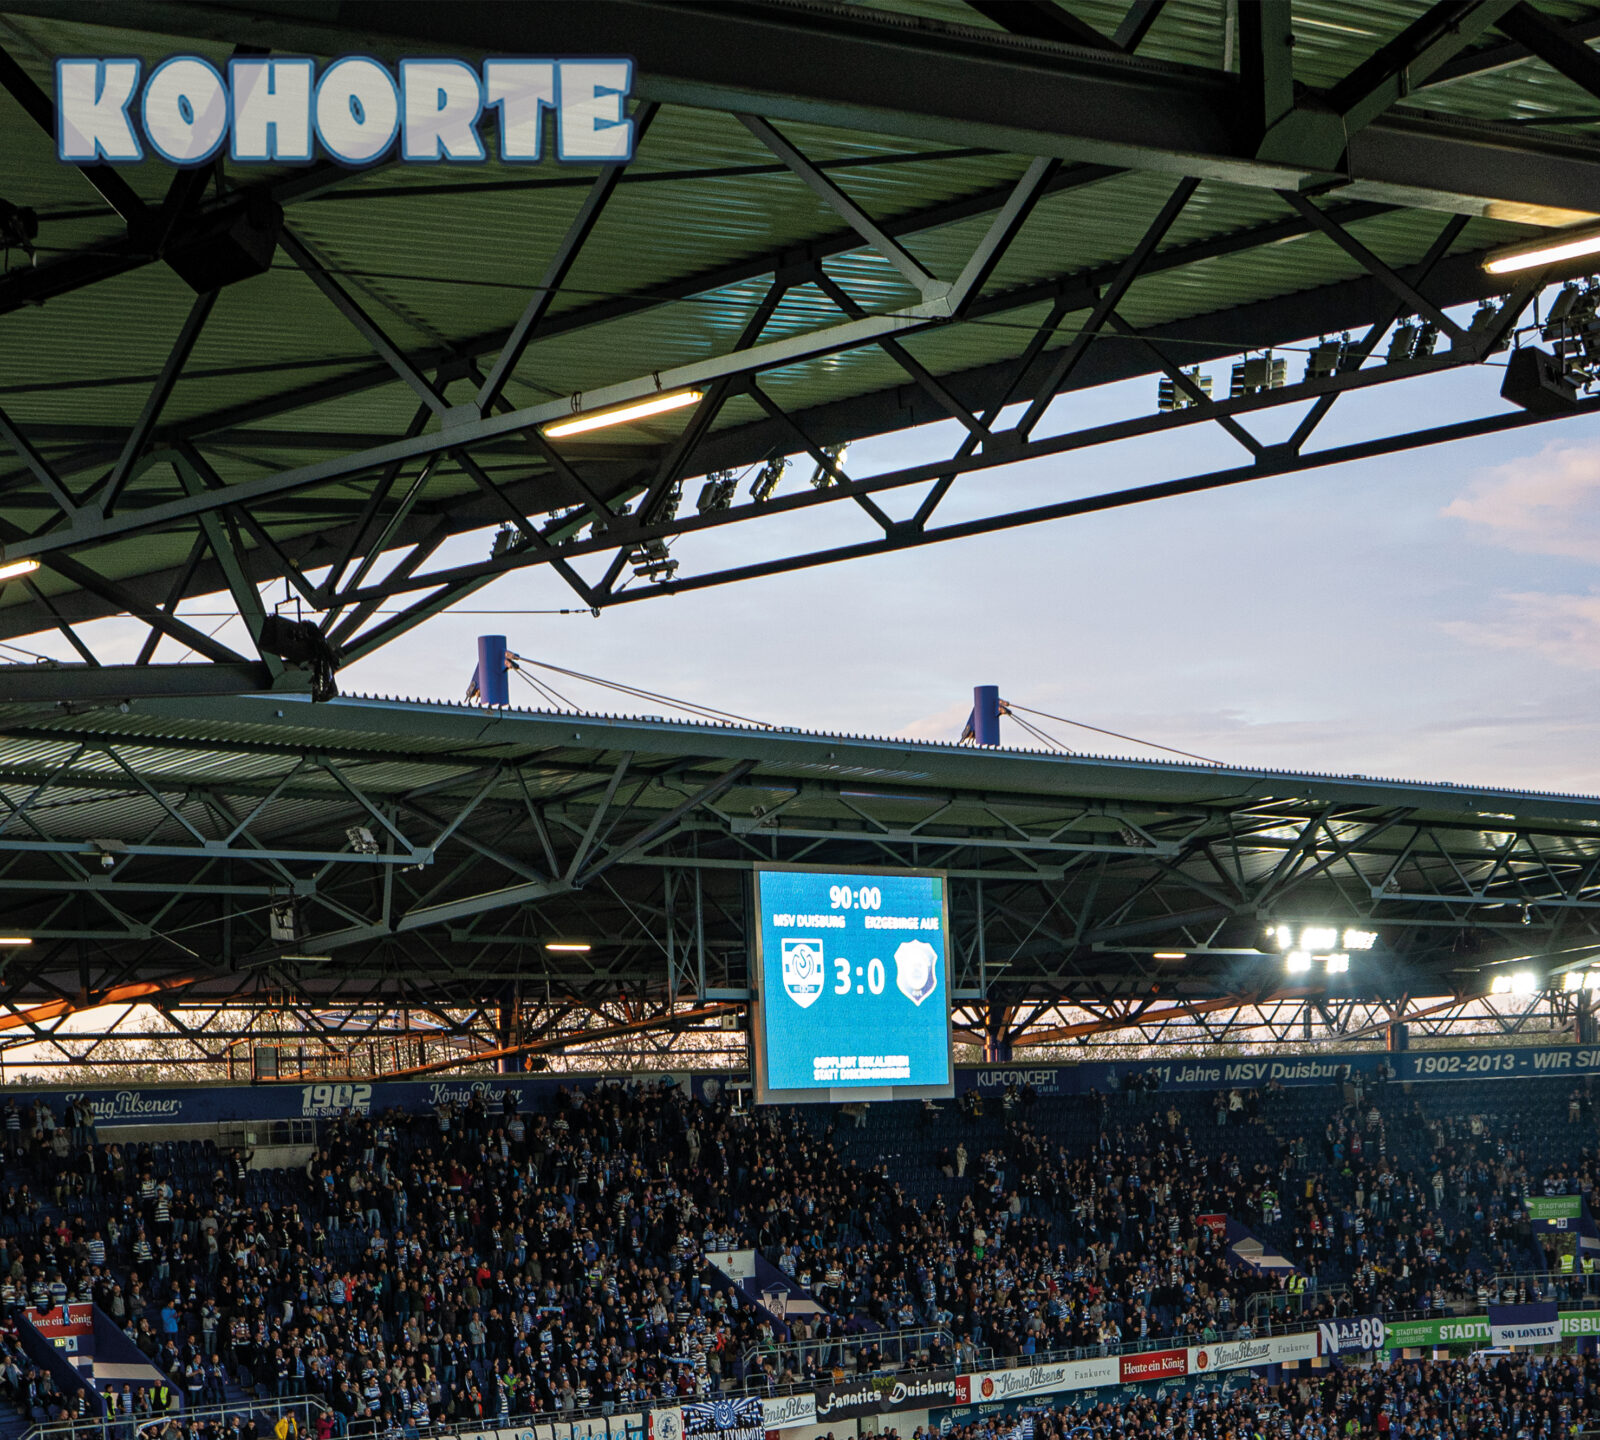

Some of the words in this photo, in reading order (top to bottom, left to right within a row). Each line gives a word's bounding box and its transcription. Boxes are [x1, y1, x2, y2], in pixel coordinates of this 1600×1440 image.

[829, 885, 882, 910] 90:00
[773, 914, 795, 928] MSV
[797, 914, 846, 929] DUISBURG
[834, 957, 886, 995] 3:0
[1175, 1066, 1220, 1083] Jahre
[1224, 1062, 1268, 1081] MSV
[1414, 1053, 1515, 1074] 1902-2013
[1534, 1051, 1572, 1069] WIR
[302, 1084, 372, 1108] 1902
[1360, 1317, 1385, 1350] 89
[1501, 1330, 1514, 1339] SO
[1517, 1326, 1555, 1338] LONELY
[1074, 1367, 1111, 1380] Fankurve
[1123, 1362, 1147, 1375] Heute
[1148, 1360, 1160, 1371] ein
[1161, 1357, 1185, 1372] König
[817, 1387, 882, 1415] Fanatics
[889, 1380, 956, 1404] Duisburg
[763, 1403, 788, 1421] önig
